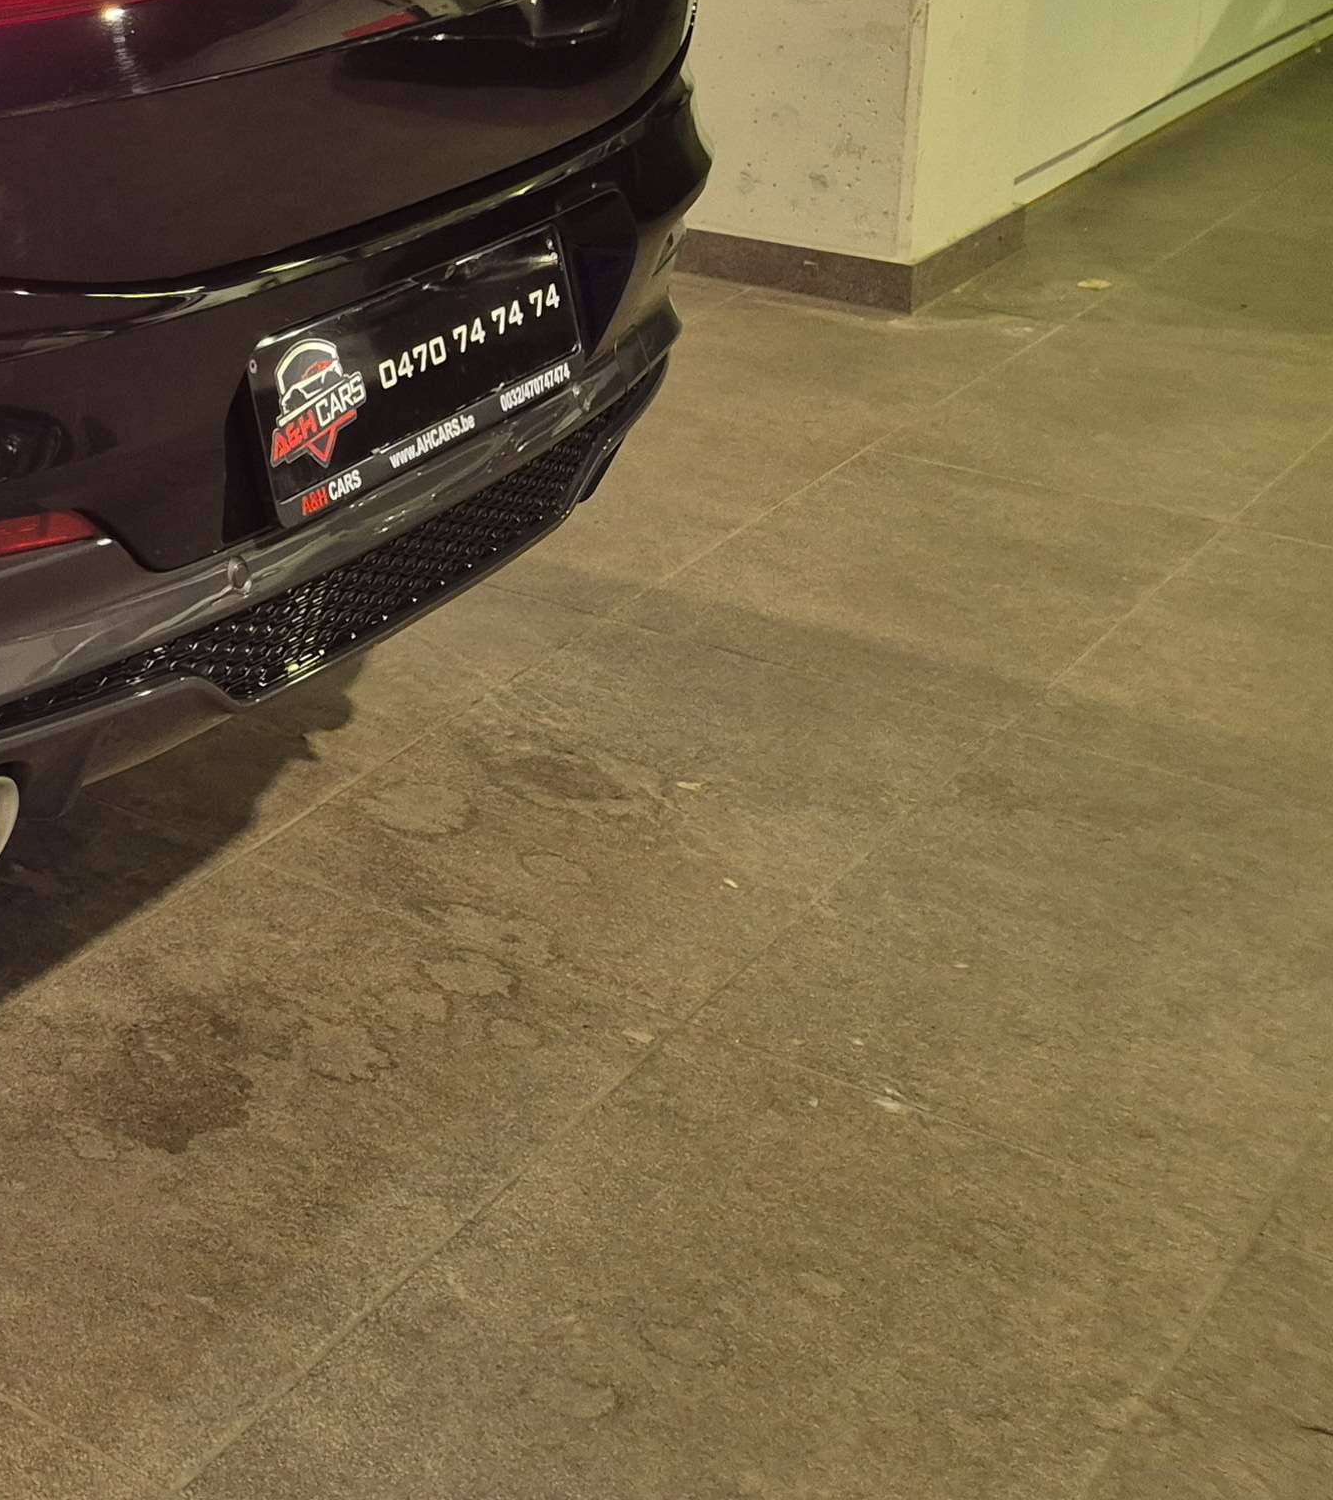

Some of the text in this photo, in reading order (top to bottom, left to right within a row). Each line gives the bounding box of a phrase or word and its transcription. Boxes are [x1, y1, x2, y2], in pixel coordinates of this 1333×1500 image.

[378, 283, 560, 389] 0470 74 74 74
[273, 375, 366, 463] A&H CARS
[301, 362, 571, 516] A&H CARS www.AHCARS.be 0032/470747474
